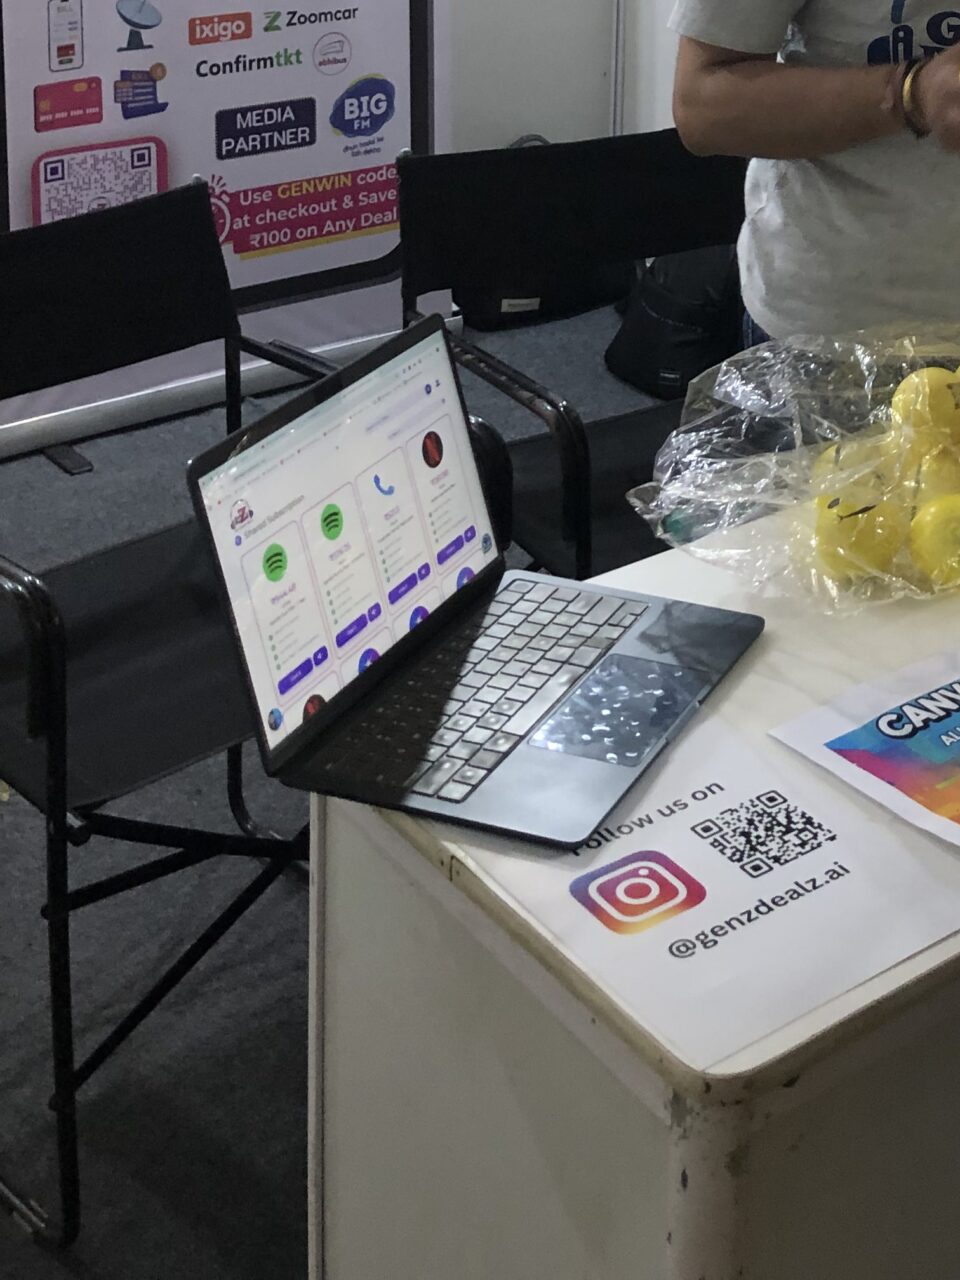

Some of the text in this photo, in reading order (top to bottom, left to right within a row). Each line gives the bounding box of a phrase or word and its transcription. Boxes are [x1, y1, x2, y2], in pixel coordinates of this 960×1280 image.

[195, 17, 245, 42] ixigo
[286, 7, 359, 27] Zoomcar
[195, 47, 303, 78] Confirmtkt
[236, 106, 295, 129] MEDIA
[344, 93, 388, 120] BIG
[354, 119, 371, 131] FM
[222, 126, 310, 155] PARTNER
[240, 166, 397, 205] Use GENWIN code
[232, 189, 397, 230] at checkout & Save
[251, 208, 397, 248] ₹100 on Any Deal
[657, 798, 689, 818] us
[691, 782, 725, 801] on
[668, 861, 850, 959] @genzdealz.ai
